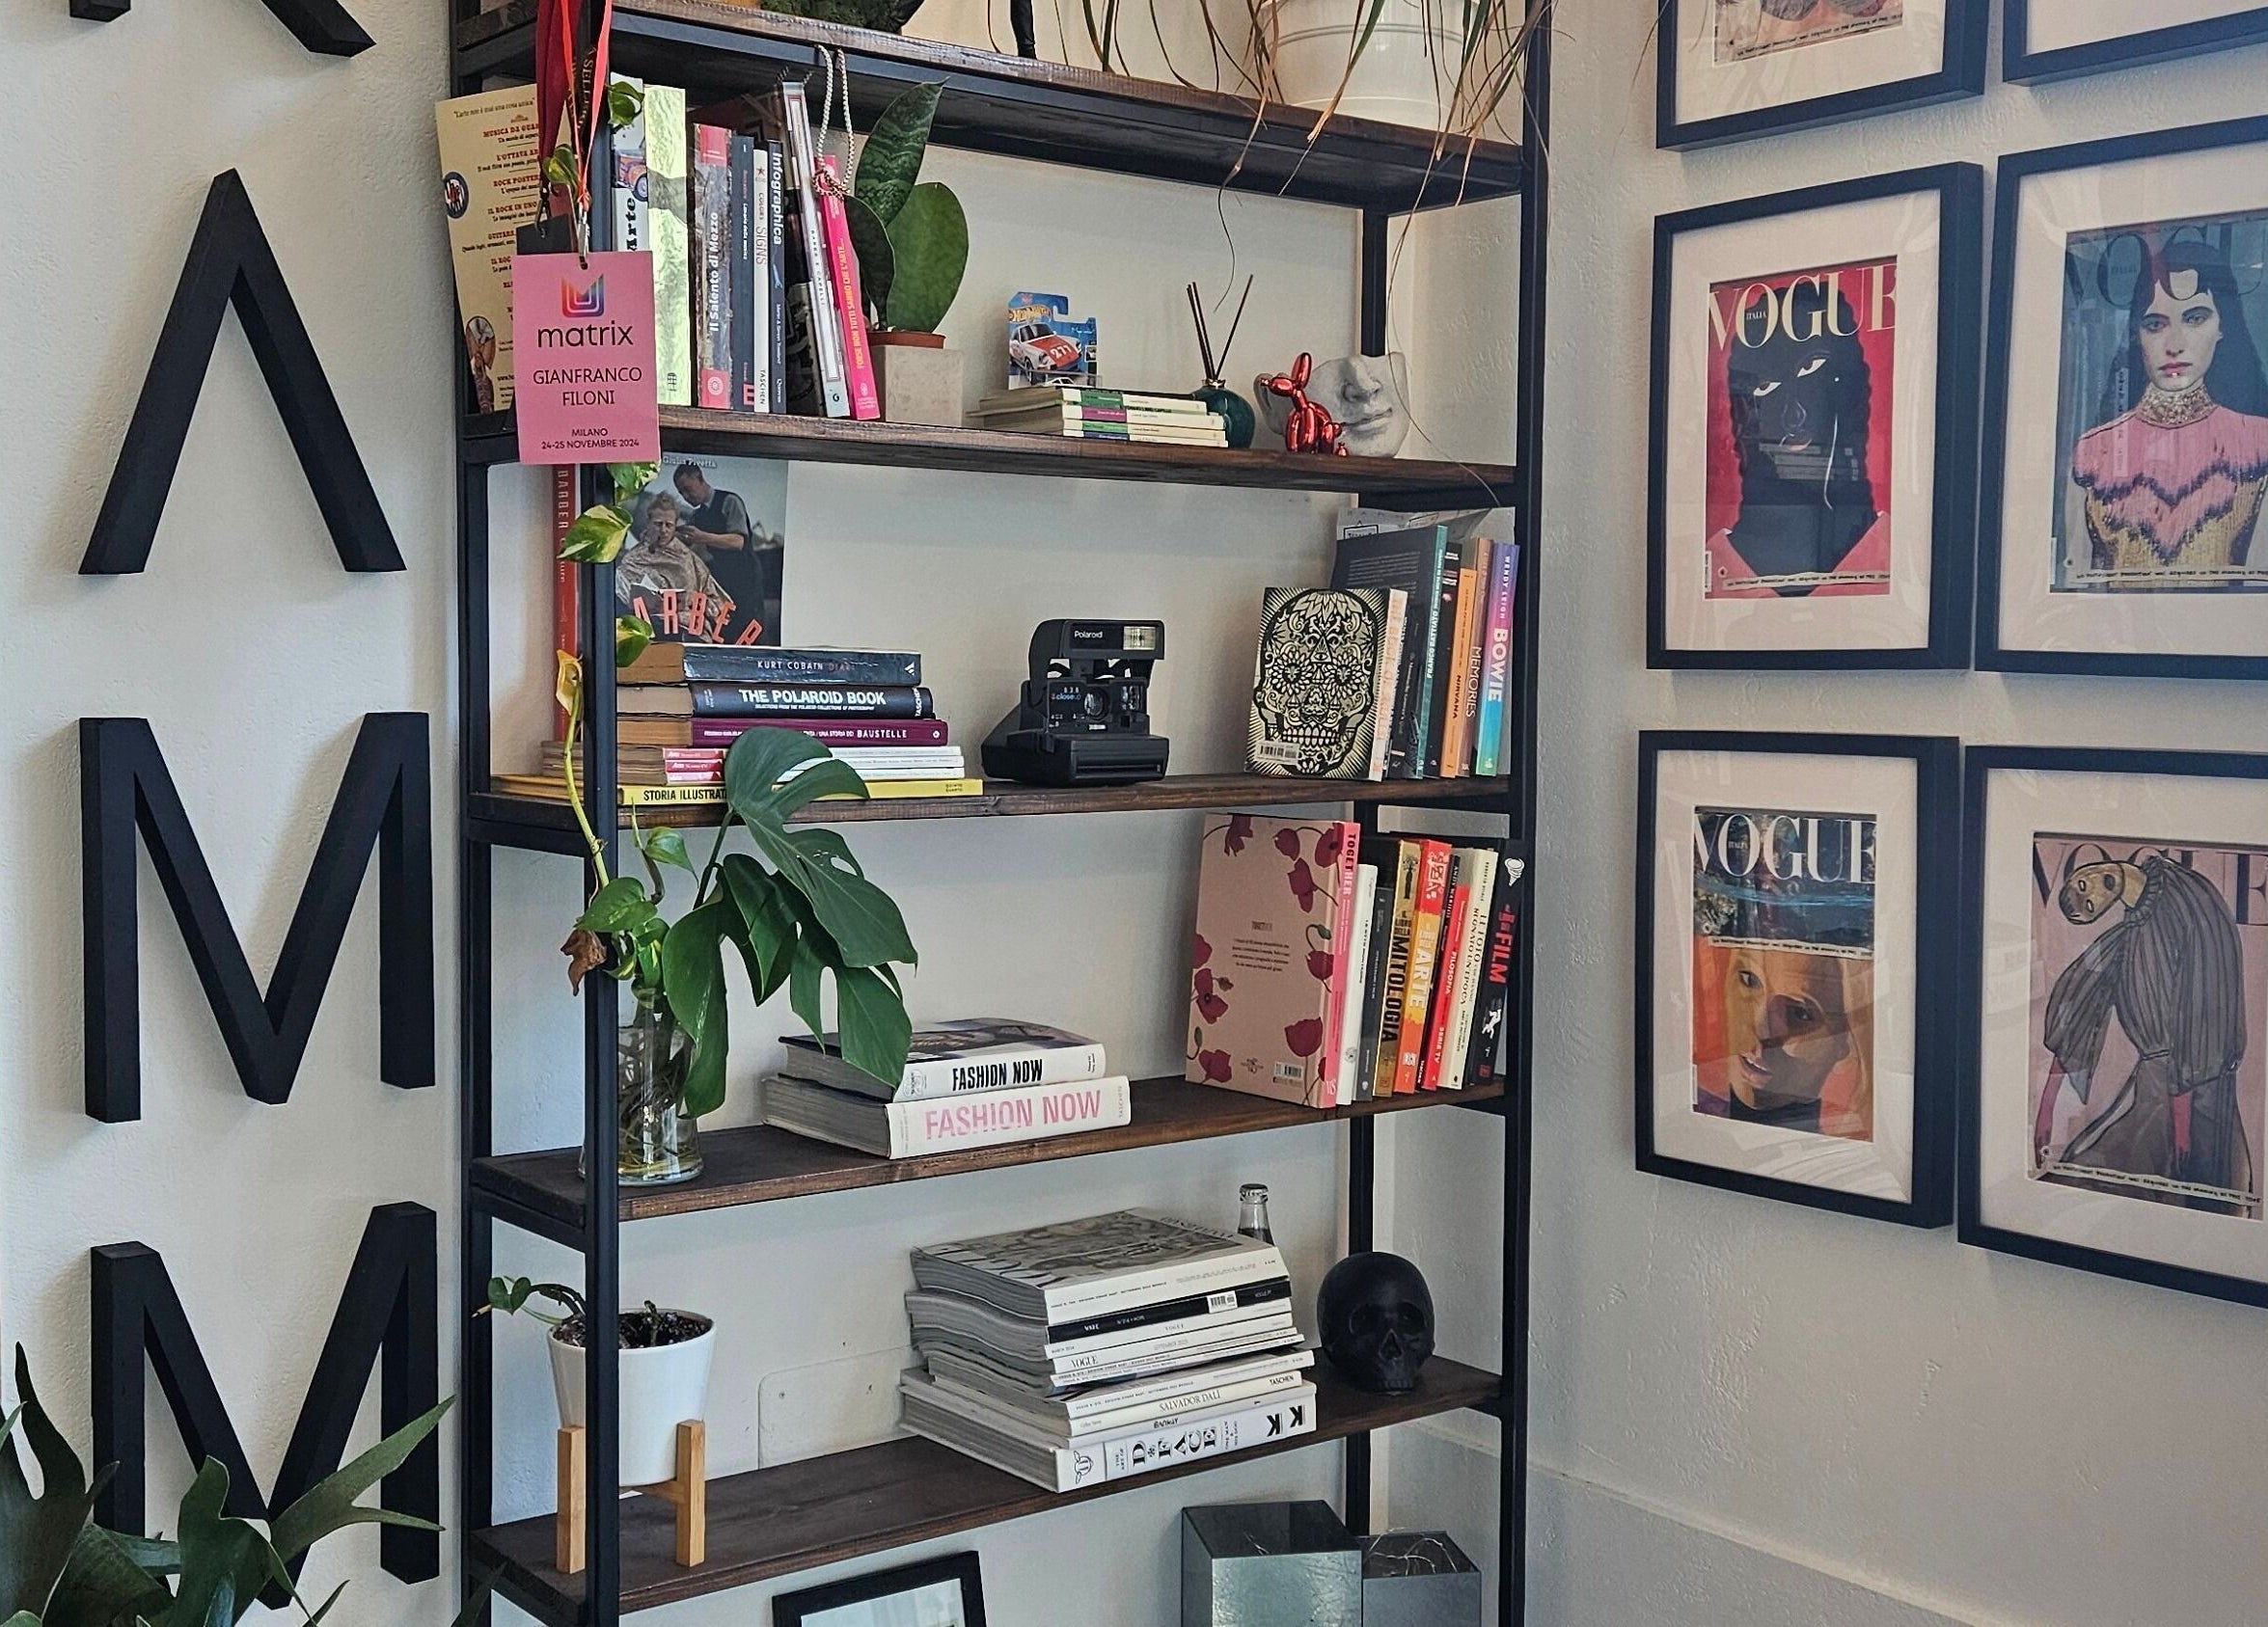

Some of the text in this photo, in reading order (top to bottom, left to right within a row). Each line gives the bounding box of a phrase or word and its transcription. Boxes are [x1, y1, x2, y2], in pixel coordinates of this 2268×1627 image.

[771, 151, 784, 246] Infographica
[709, 211, 720, 254] Mezzo
[755, 225, 768, 266] SIGNS
[708, 255, 720, 269] di
[842, 269, 851, 285] CHE
[709, 269, 720, 321] Salento
[844, 284, 856, 310] SANNO
[1708, 262, 1898, 351] VOGUE
[848, 310, 859, 330] TUTTI
[1746, 310, 1767, 321] ITALIA
[537, 320, 634, 348] matrix
[852, 329, 861, 347] NON
[855, 346, 866, 369] FORSE
[533, 366, 642, 385] GIANFRANCO
[562, 390, 615, 406] FILONI
[541, 439, 640, 449] 24-25 NOVEMBRE 2024
[571, 427, 609, 438] MILANO
[558, 470, 569, 530] BARBER
[1502, 556, 1512, 588] WENDY
[1074, 630, 1103, 638] Polaroid
[1429, 610, 1438, 647] BATTIATO
[757, 660, 782, 670] KURT
[787, 661, 824, 671] COBAIN
[1426, 647, 1435, 679] FRANCO
[1488, 627, 1509, 703] BOWIE
[1465, 646, 1483, 719] MEMORIES
[739, 689, 887, 706] THE POLAROID BOOK
[1452, 675, 1462, 719] NIRVANA
[857, 729, 908, 739] BAUSTELLE
[643, 788, 727, 801] STORIA ILLUSTRAT
[1342, 833, 1357, 896] TOGETHER
[1489, 932, 1514, 984] FILM
[1381, 936, 1410, 1043] MITOLOGIA
[1408, 947, 1432, 1010] ARTE
[1434, 951, 1458, 1063] FILOSOFIA SERIE TV
[952, 1058, 1043, 1091] FASHION NOW
[925, 1098, 1033, 1140] FASHION
[1042, 1090, 1101, 1125] NOW
[1071, 1355, 1099, 1369] VOGUE
[1270, 1374, 1295, 1386] TASCHEN
[1159, 1395, 1200, 1412] SALVADOR
